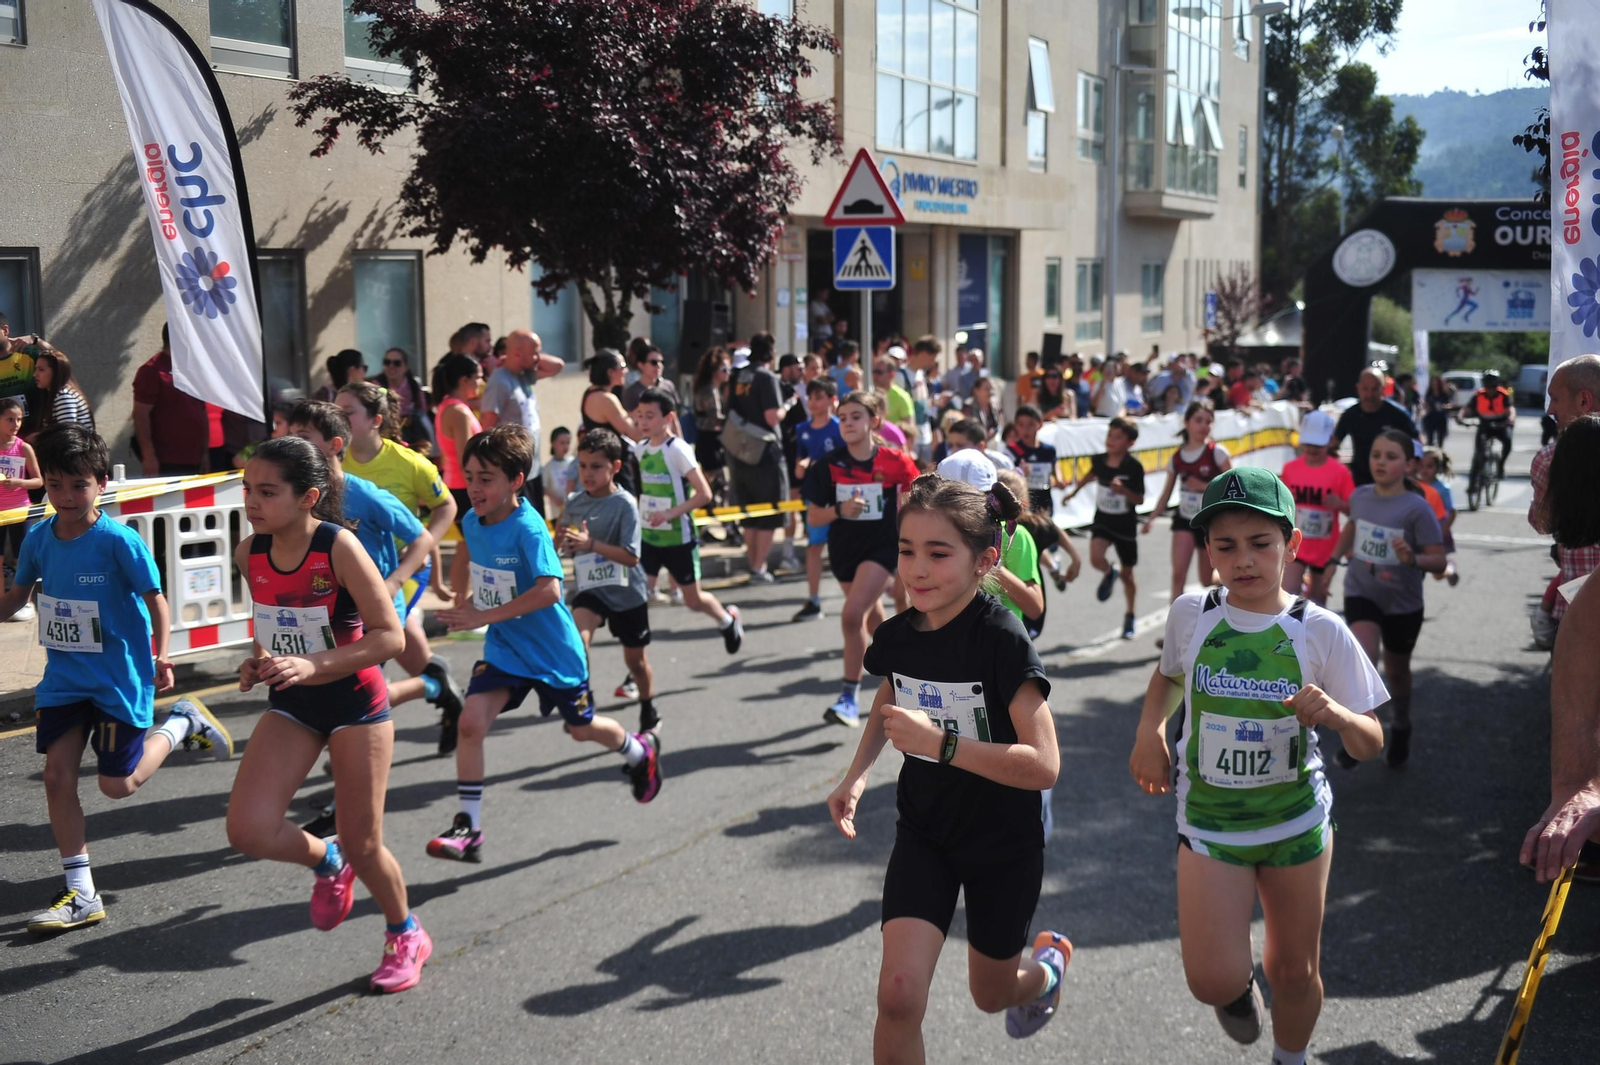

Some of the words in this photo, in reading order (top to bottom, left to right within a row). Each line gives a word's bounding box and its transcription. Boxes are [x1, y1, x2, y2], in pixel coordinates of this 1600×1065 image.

[1495, 225, 1551, 246] OUR
[1221, 474, 1246, 500] A
[1361, 540, 1388, 559] 4218
[79, 575, 105, 583] auro
[588, 564, 615, 582] 4312
[479, 586, 502, 607] 4314
[47, 620, 80, 643] 4313
[271, 633, 307, 655] 4311
[1197, 665, 1298, 695] Natursueño
[1226, 690, 1251, 698] natural
[100, 722, 117, 752] 11
[1205, 723, 1227, 732] 2026
[1216, 748, 1271, 776] 4012
